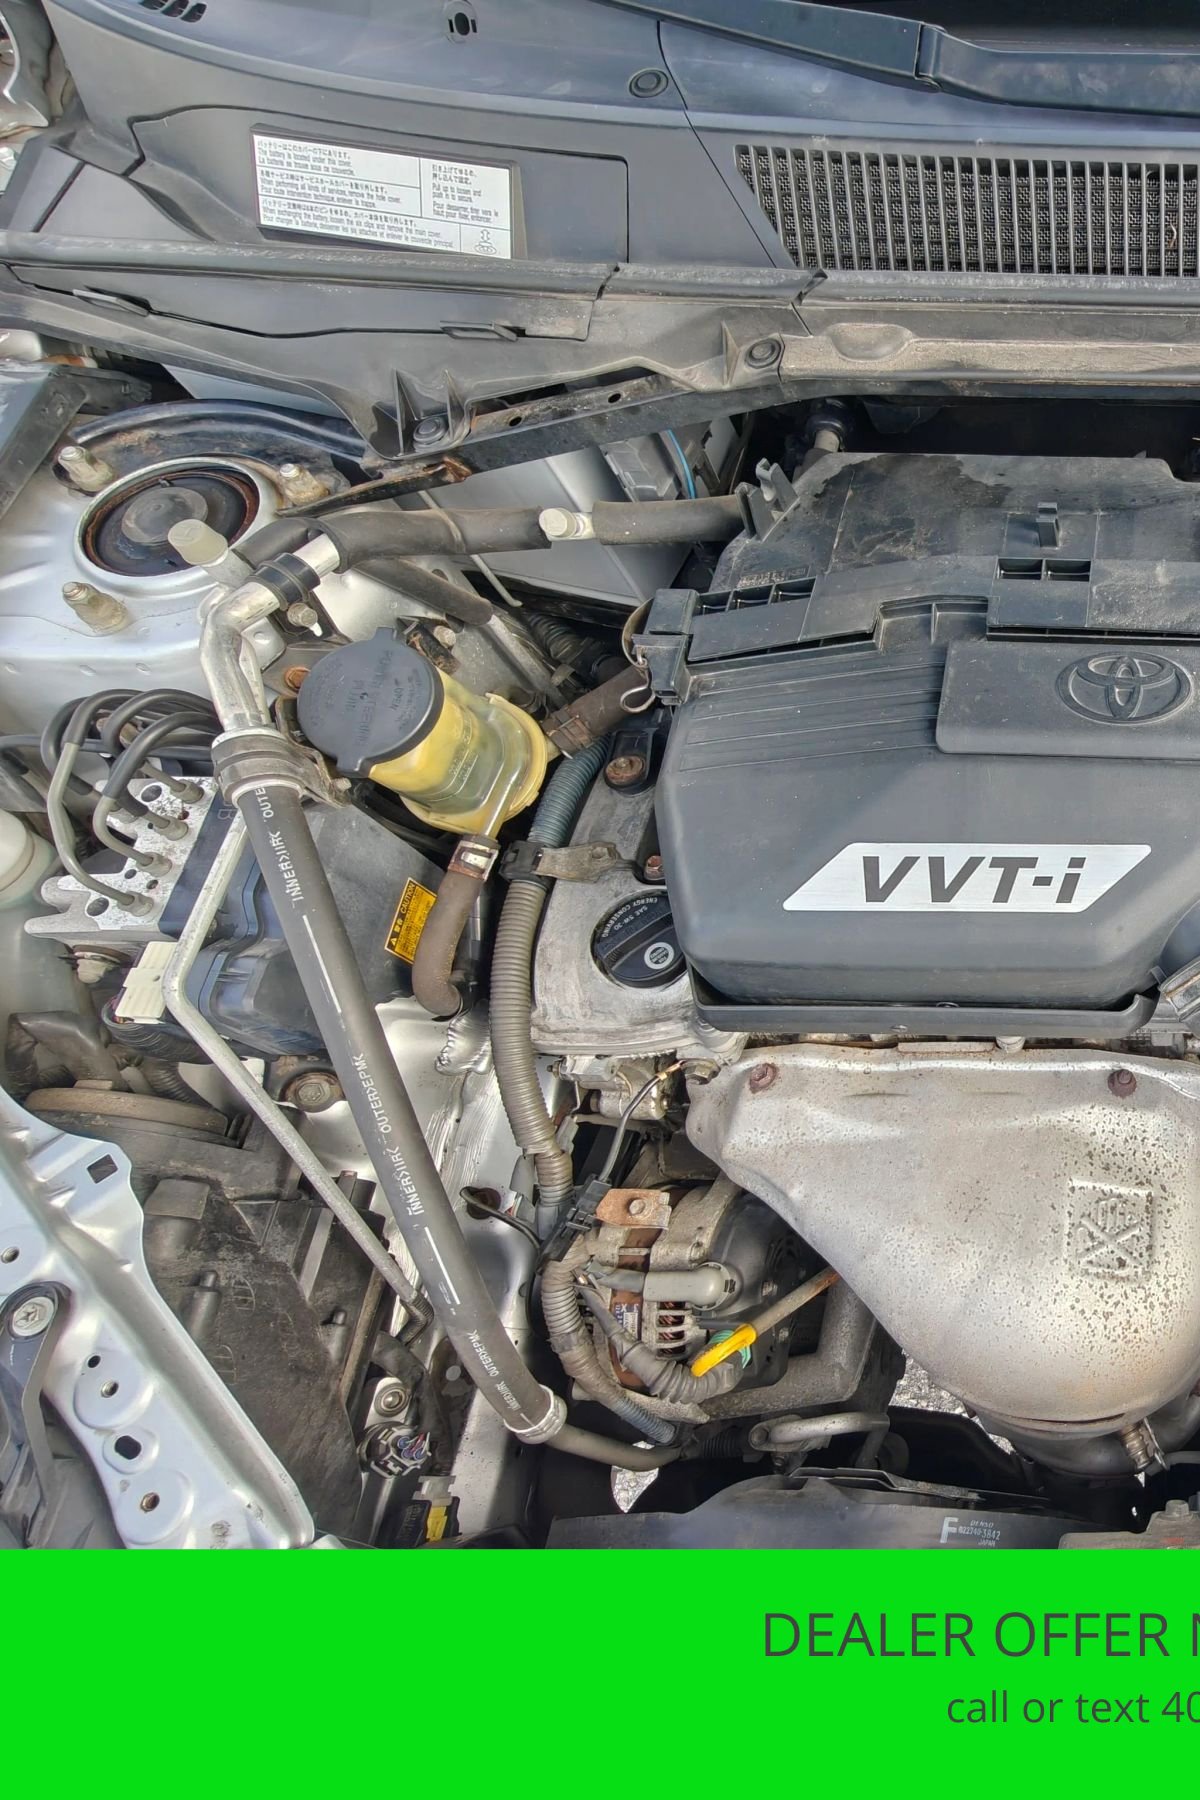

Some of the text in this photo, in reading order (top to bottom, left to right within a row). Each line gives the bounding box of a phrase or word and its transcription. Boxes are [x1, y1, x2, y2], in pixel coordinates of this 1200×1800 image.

[862, 855, 1087, 904] VVT-i
[940, 1517, 959, 1543] F
[970, 1519, 994, 1529] DENSO
[977, 1539, 996, 1547] JAPAN
